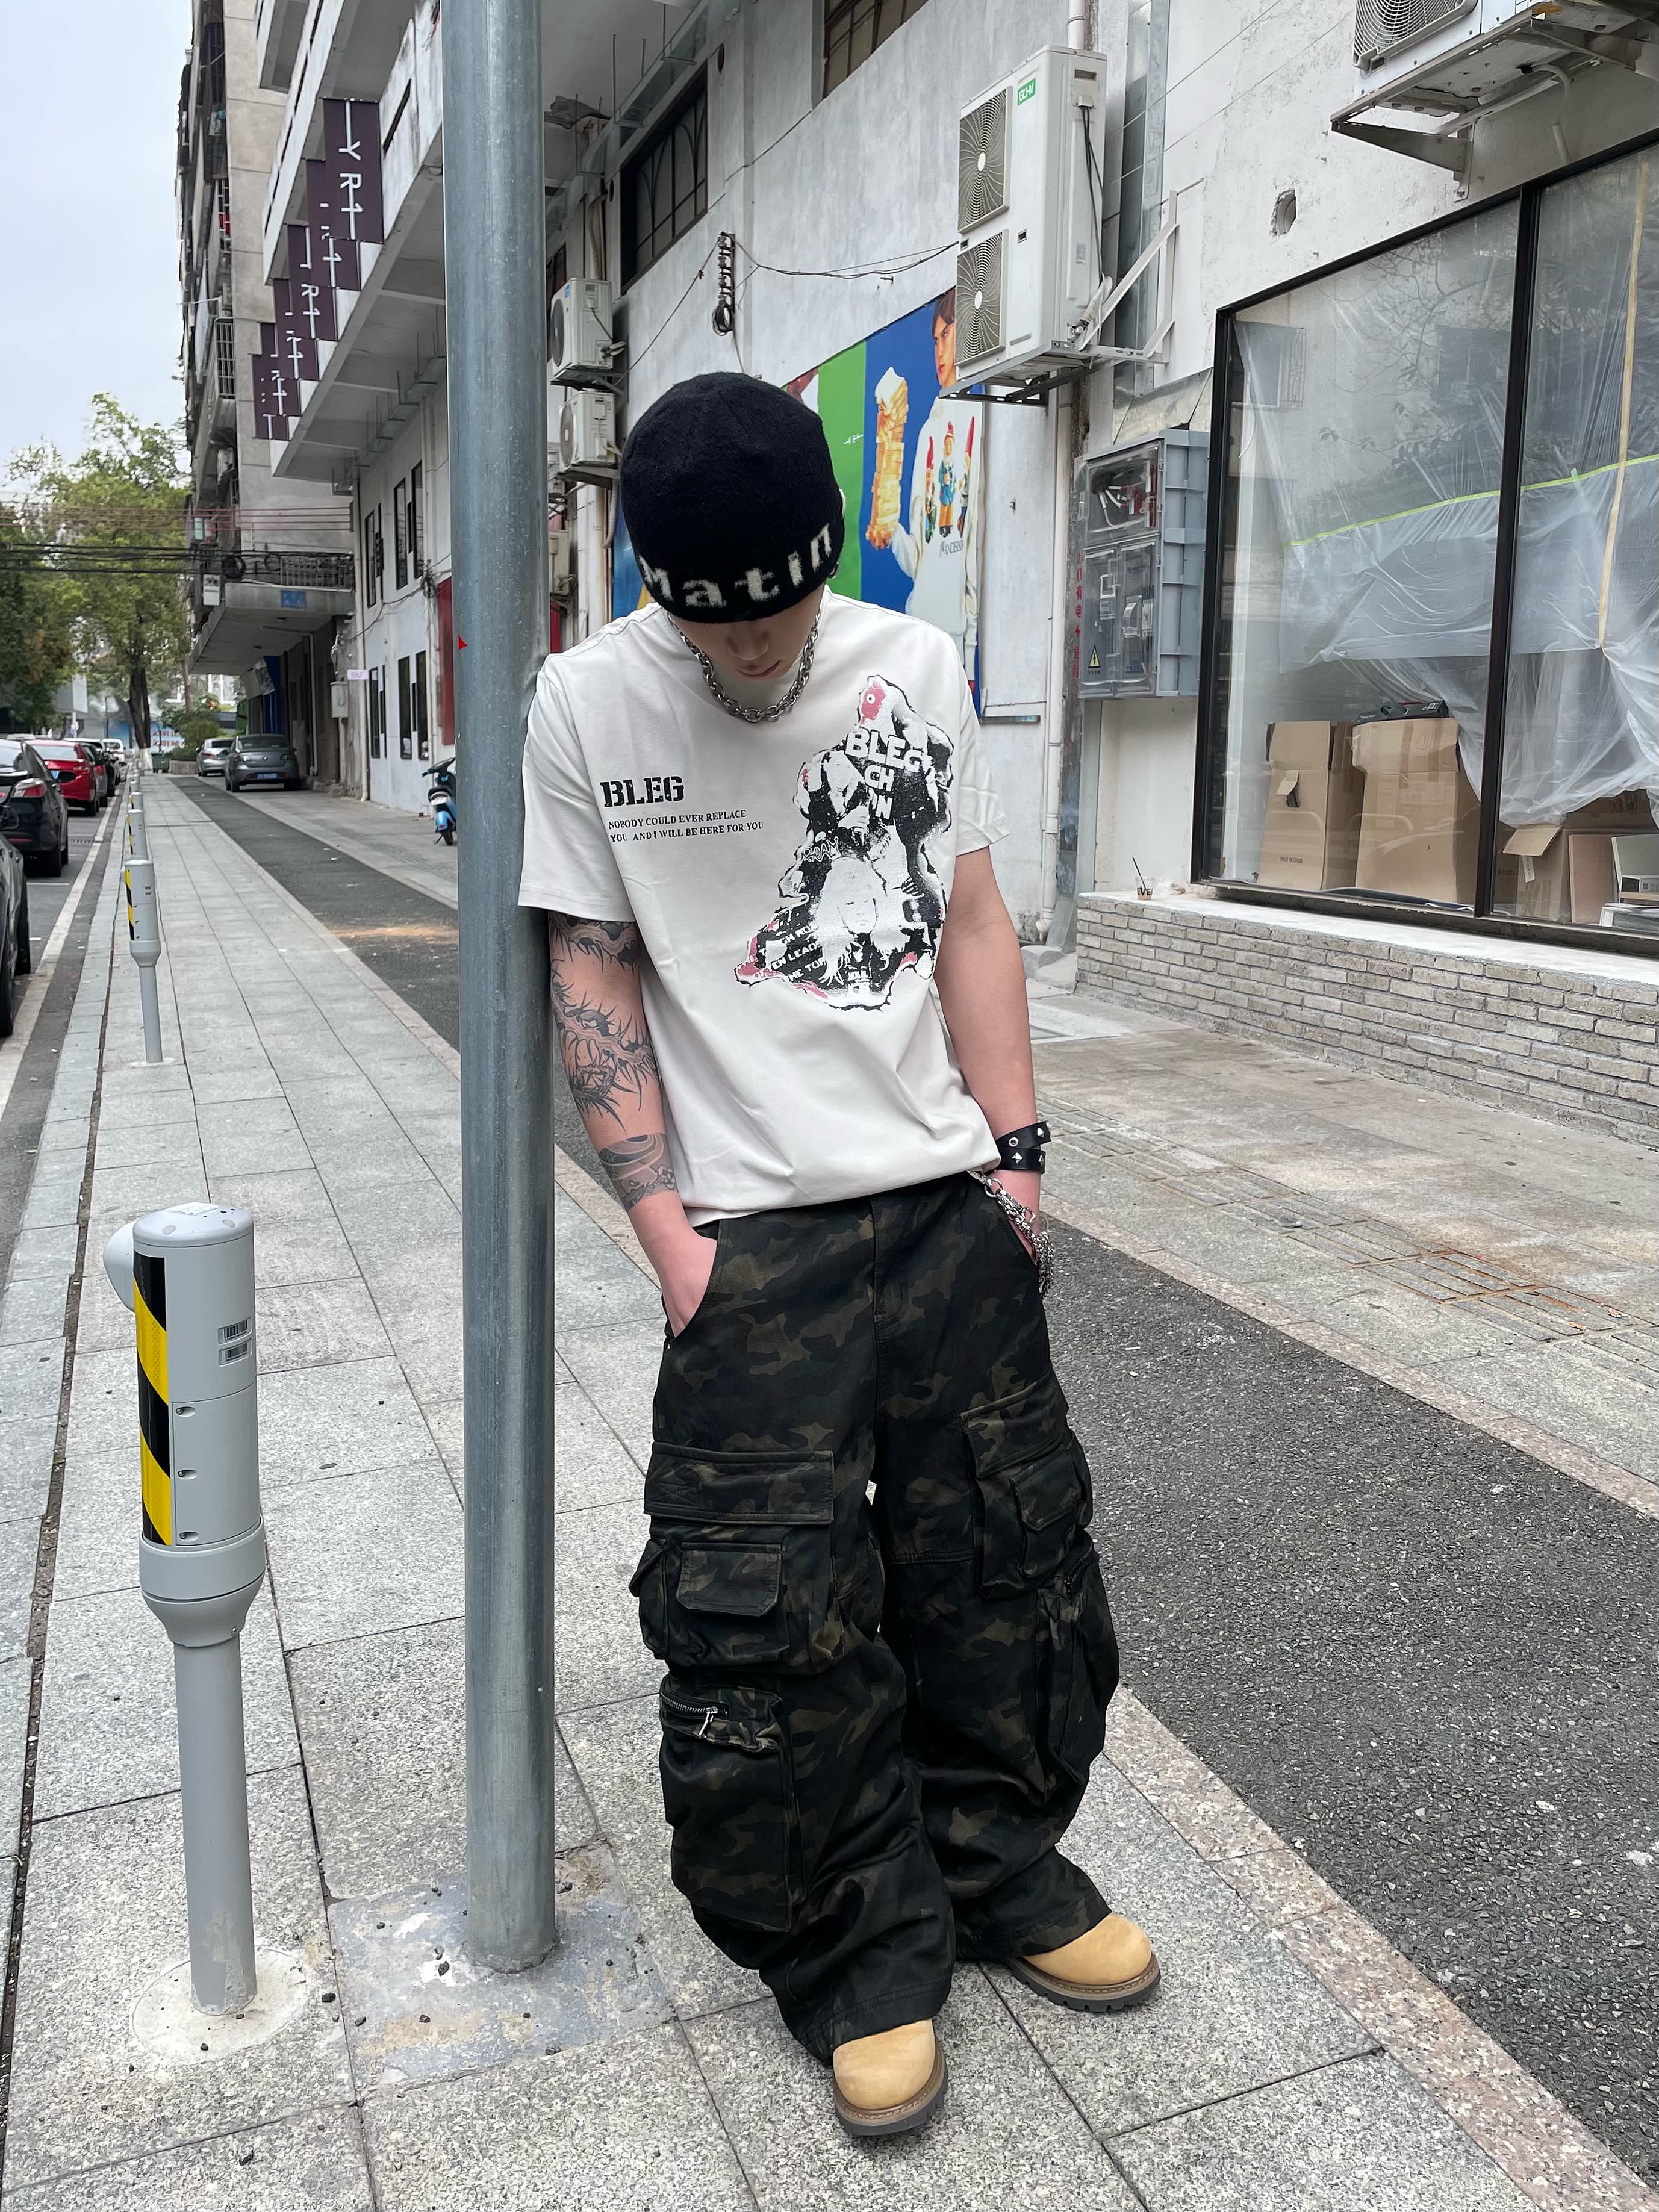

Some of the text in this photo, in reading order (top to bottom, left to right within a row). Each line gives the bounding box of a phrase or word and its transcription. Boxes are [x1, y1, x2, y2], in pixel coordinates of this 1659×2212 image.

[845, 728, 923, 774] BLEG
[600, 776, 685, 807] BLEG
[608, 810, 746, 830] NOBODY COULD EVER REPLACE
[610, 834, 627, 843] YOU
[633, 831, 652, 841] AND
[659, 829, 683, 838] WILL
[685, 828, 697, 836] BE
[699, 825, 725, 835] HERE
[727, 824, 744, 833] FOR
[746, 821, 764, 831] YOU
